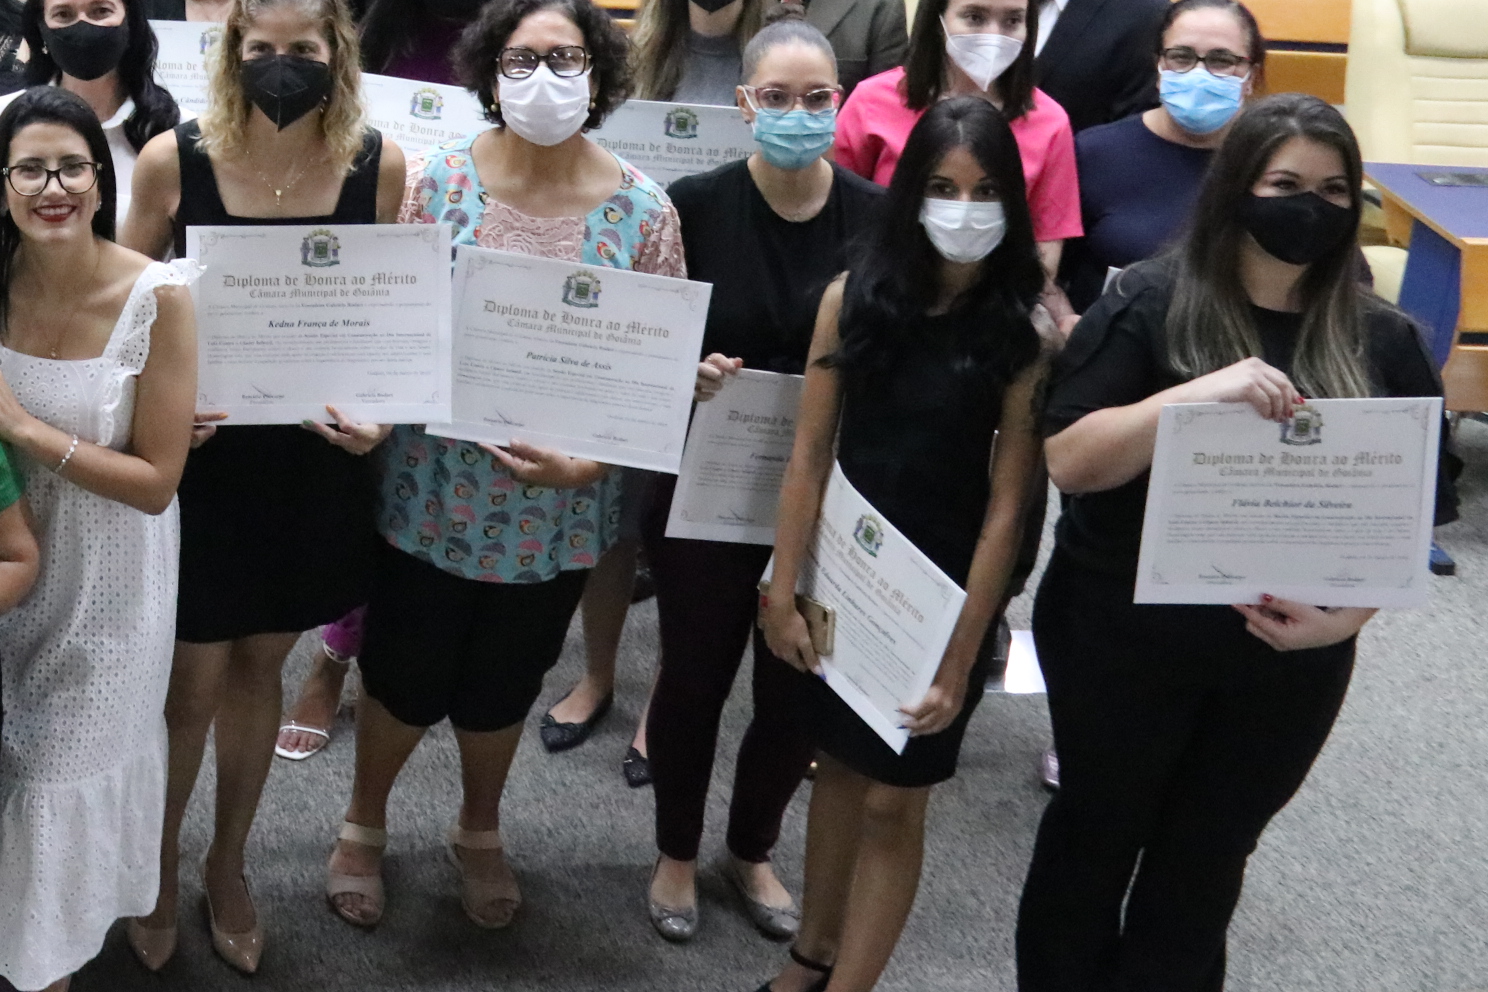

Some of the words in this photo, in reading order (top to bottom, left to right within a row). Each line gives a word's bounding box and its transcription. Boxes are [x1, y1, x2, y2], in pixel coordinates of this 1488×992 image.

[393, 121, 404, 131] de
[410, 122, 445, 137] Honra
[396, 134, 436, 145] Municipal
[649, 143, 662, 152] de
[666, 143, 703, 155] Honra
[706, 148, 720, 156] ao
[652, 154, 694, 165] Municipal
[223, 274, 280, 288] Diploma
[285, 274, 298, 287] de
[305, 273, 346, 287] Honra
[350, 277, 365, 286] ao
[371, 272, 417, 286] Mérito
[249, 289, 287, 298] Câmara
[289, 289, 337, 299] Municipal
[340, 289, 351, 297] de
[352, 288, 390, 297] Goiânia
[268, 319, 295, 328] Kedna
[297, 319, 327, 329] França
[329, 319, 339, 328] de
[341, 319, 371, 328] Morais
[483, 300, 539, 322] Diploma
[542, 308, 557, 322] de
[561, 311, 602, 330] Honra
[606, 320, 620, 331] ao
[624, 321, 670, 338] Mérito
[507, 318, 543, 332] Câmara
[545, 324, 591, 340] Municipal
[594, 330, 603, 340] de
[605, 333, 642, 346] Goiânia
[560, 356, 580, 366] Silva
[581, 359, 590, 368] de
[592, 360, 612, 370] Assis
[727, 410, 777, 425] Diploma
[1192, 452, 1253, 466] Diploma
[1259, 452, 1274, 465] de
[1279, 451, 1327, 466] Honra
[1332, 455, 1348, 466] ao
[1352, 451, 1402, 466] Mérito
[1218, 468, 1260, 478] Câmara
[1263, 468, 1315, 478] Municipal
[1318, 468, 1329, 477] de
[1332, 468, 1372, 477] Goiânia
[847, 545, 877, 580] Honra
[878, 577, 889, 591] ao
[890, 587, 925, 623] Mérito
